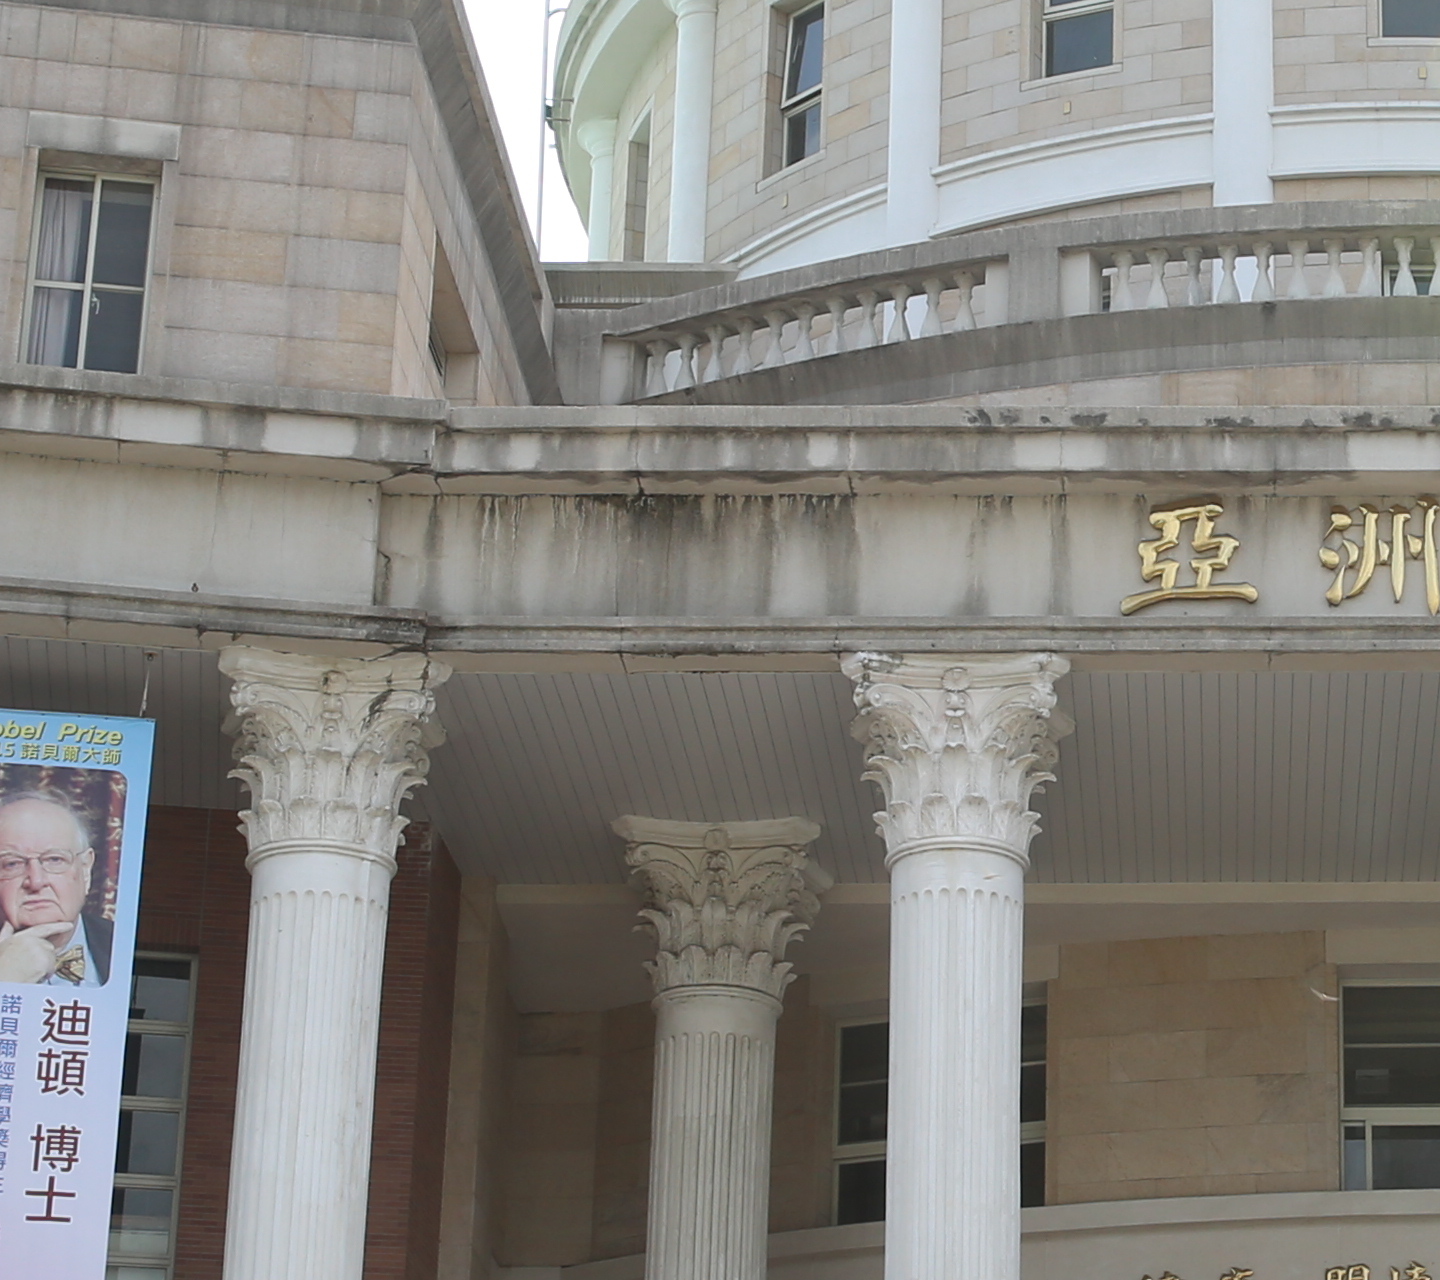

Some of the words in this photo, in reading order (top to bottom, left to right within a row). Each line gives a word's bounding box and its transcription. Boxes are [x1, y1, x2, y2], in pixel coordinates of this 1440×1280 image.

[20, 743, 121, 766] 諾貝爾大師
[57, 723, 123, 746] Prize
[37, 998, 91, 1097] 迪頓
[25, 1124, 82, 1223] 博士
